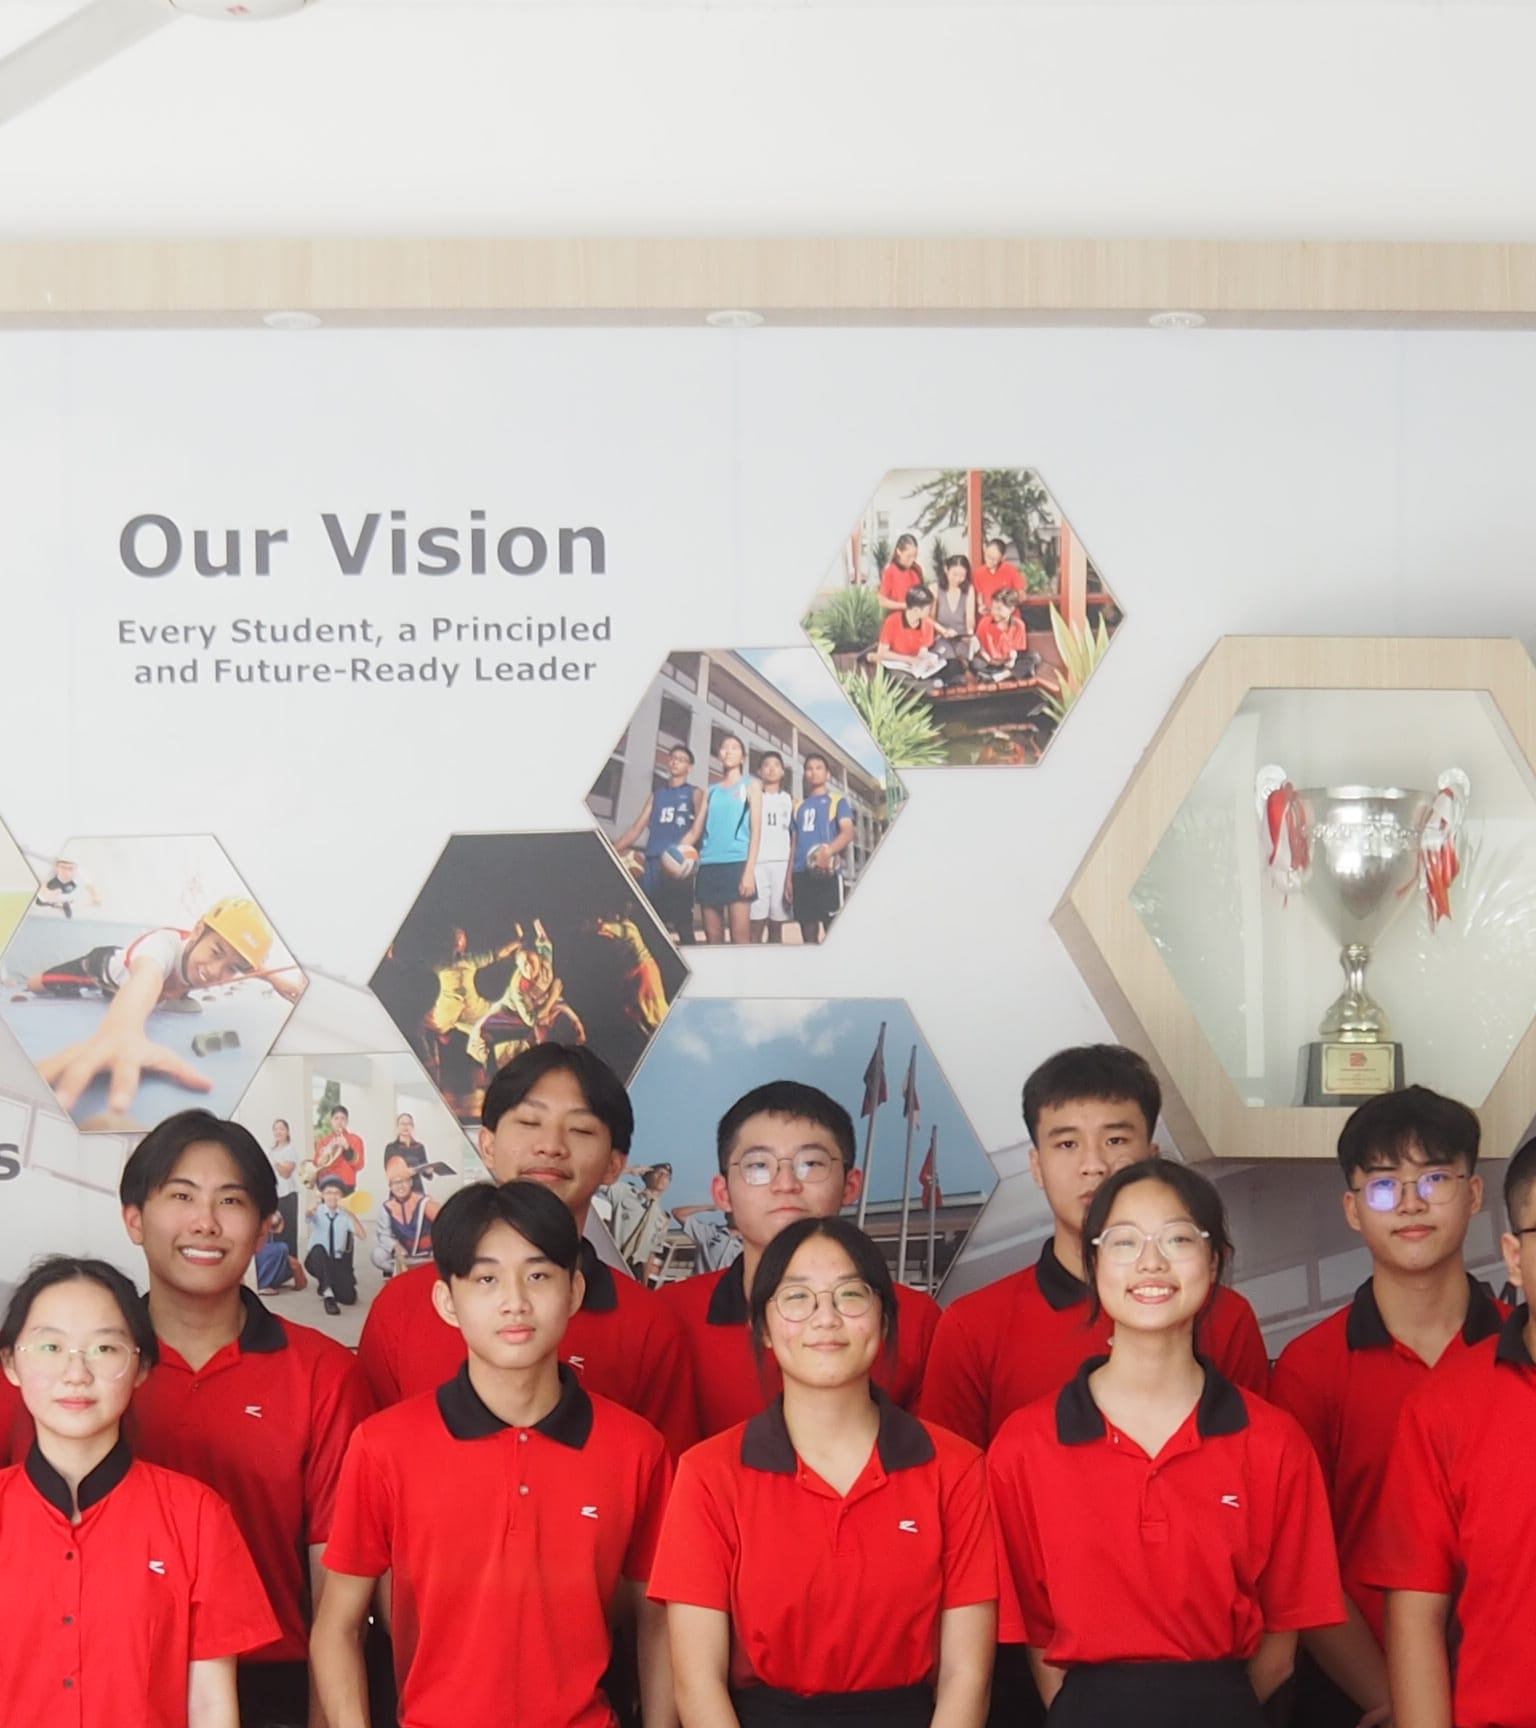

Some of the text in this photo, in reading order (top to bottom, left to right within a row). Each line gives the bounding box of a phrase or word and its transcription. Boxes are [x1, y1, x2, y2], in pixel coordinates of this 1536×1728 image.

[119, 509, 606, 578] Our Vision
[118, 615, 611, 650] Every Student, a Principled
[134, 655, 597, 689] and Future-Ready Leader
